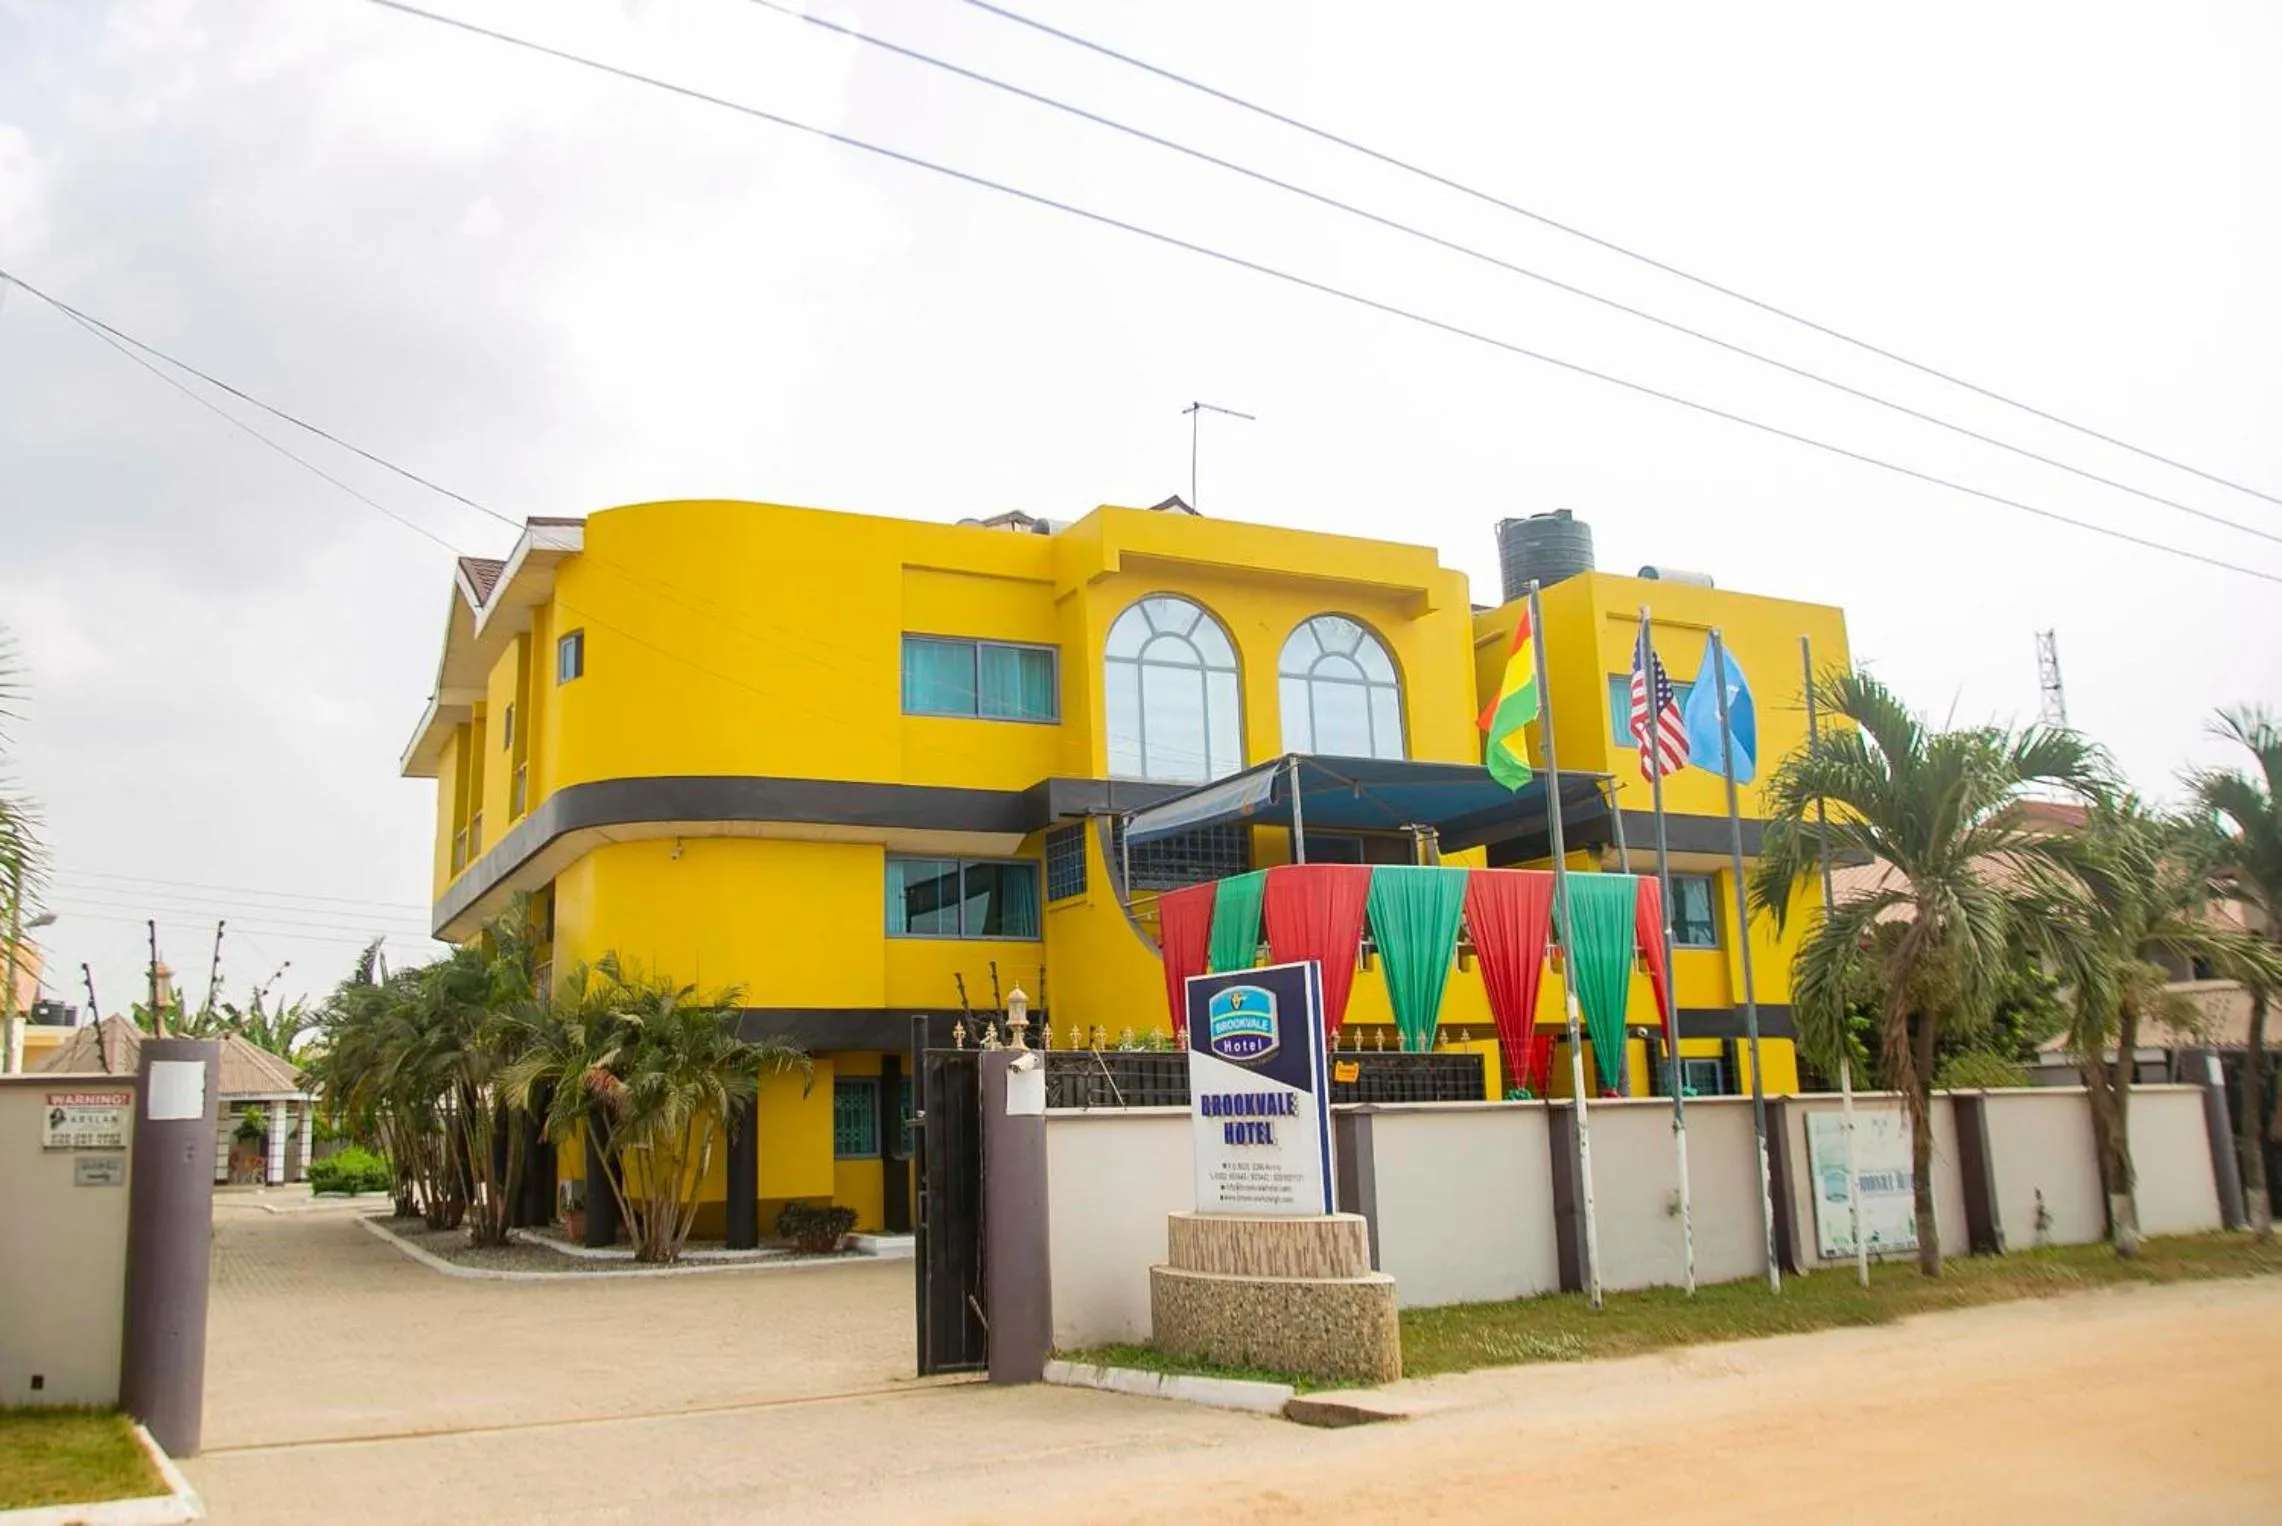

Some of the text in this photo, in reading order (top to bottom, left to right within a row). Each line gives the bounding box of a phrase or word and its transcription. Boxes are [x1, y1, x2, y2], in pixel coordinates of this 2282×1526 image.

[1215, 1017, 1269, 1034] BROOKVALE
[1224, 1038, 1262, 1053] Hotel
[51, 1095, 129, 1106] WARNING!
[1201, 1092, 1297, 1117] BROOKVALE
[1224, 1121, 1275, 1145] HOTEL
